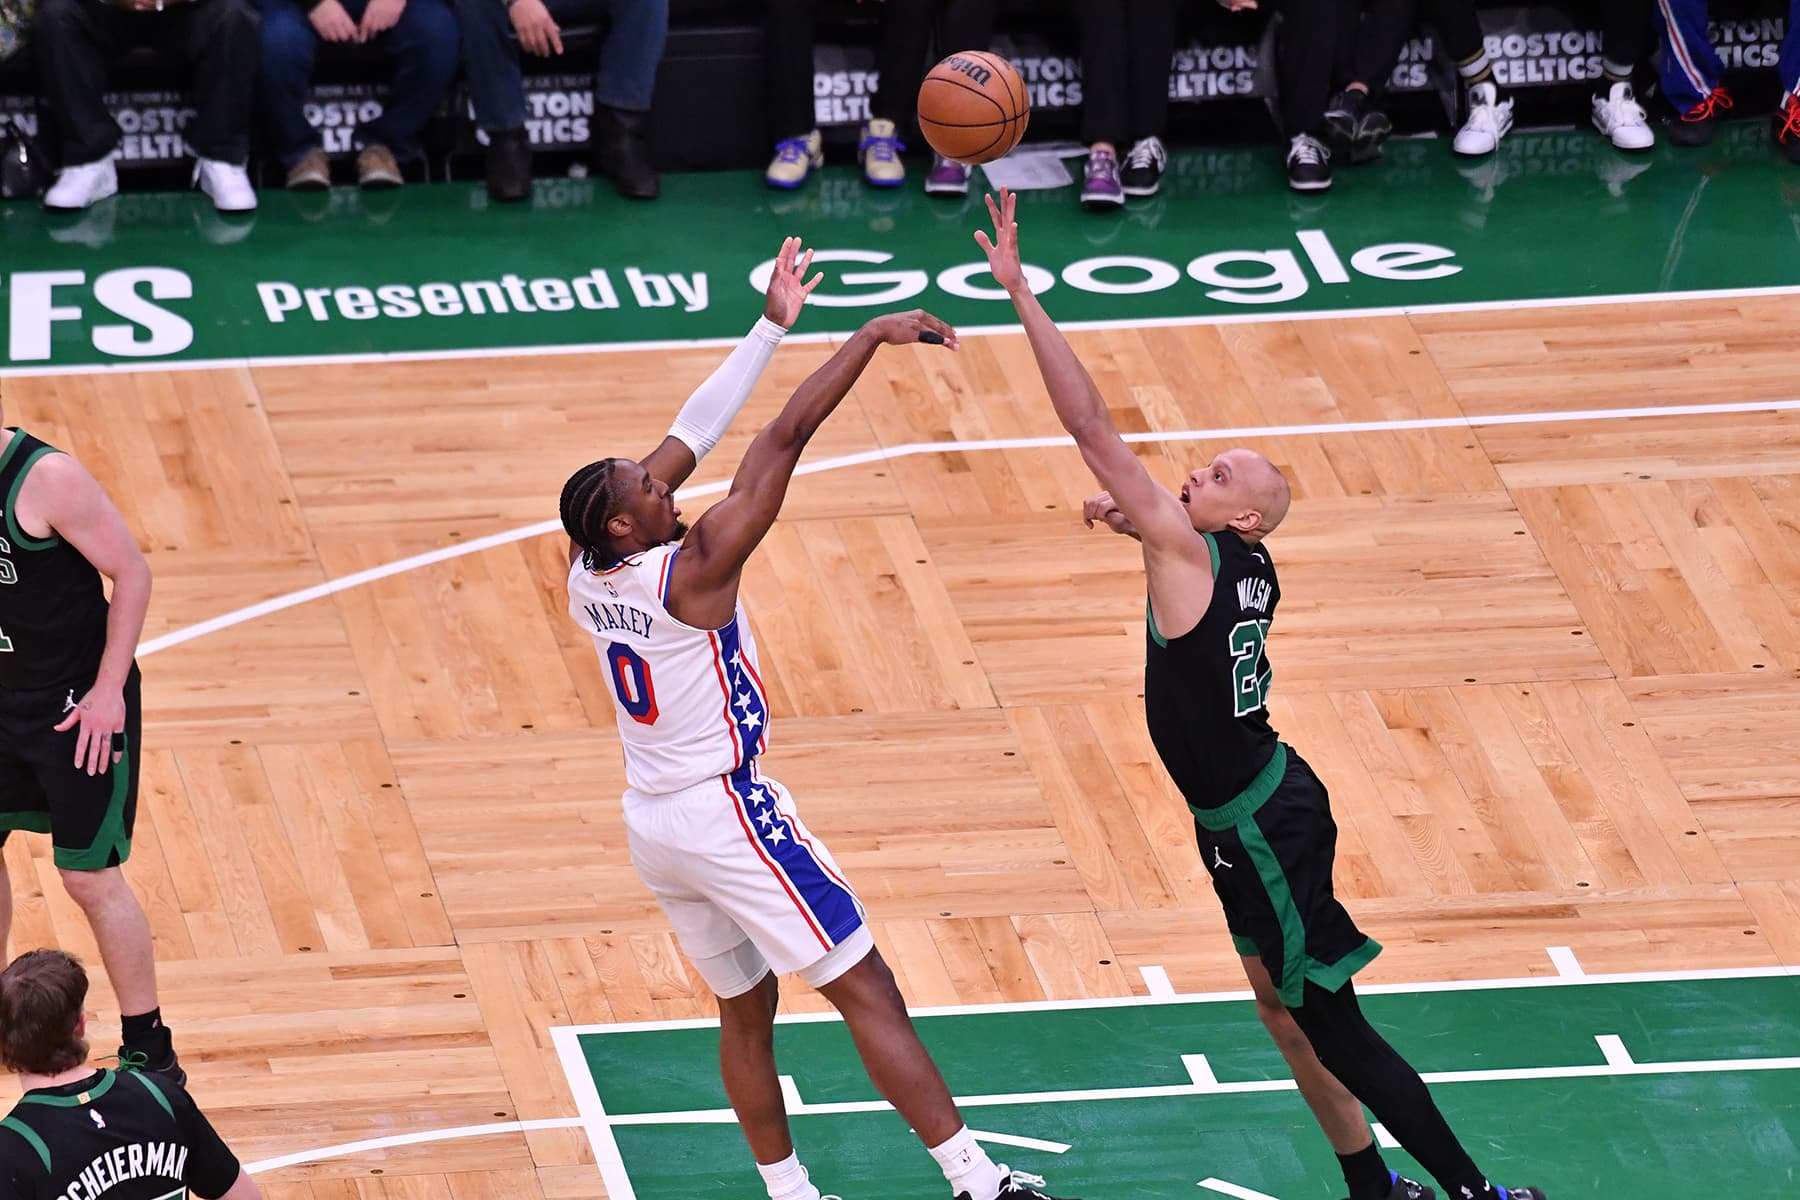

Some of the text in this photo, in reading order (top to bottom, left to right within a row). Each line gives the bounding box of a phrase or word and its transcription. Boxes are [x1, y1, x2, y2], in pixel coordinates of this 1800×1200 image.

[1707, 17, 1784, 44] STON
[1170, 45, 1257, 71] STON
[1483, 31, 1603, 59] BOSTON
[1714, 43, 1780, 68] TICS
[1009, 57, 1084, 82] STON
[1491, 56, 1604, 84] CELTICS
[303, 101, 383, 127] OSTO
[526, 91, 594, 118] TON
[815, 96, 874, 122] ELTI
[524, 117, 590, 143] TICS
[749, 229, 1463, 307] Google
[256, 267, 709, 322] Presented by
[0, 266, 194, 361] FS
[1236, 577, 1272, 613] WALSH
[584, 603, 653, 639] MAXEY
[606, 641, 659, 727] 0
[56, 1141, 188, 1200] CHEIERMAN
